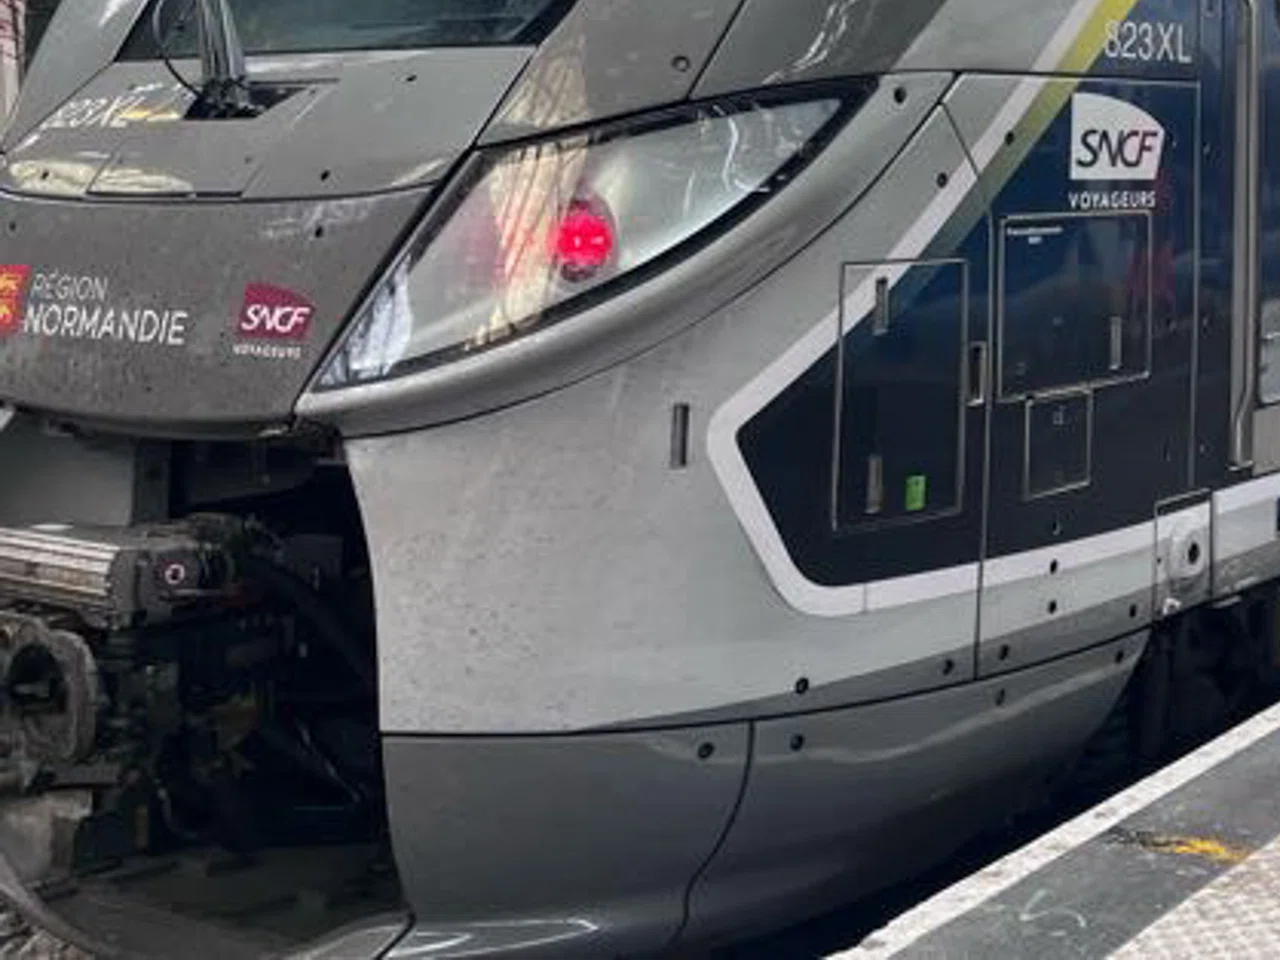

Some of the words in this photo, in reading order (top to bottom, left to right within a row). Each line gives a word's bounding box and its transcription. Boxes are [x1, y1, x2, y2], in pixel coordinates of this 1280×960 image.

[1104, 19, 1193, 64] 823XL
[1076, 129, 1158, 168] SNCF
[1068, 190, 1156, 209] VOYAGEURS
[23, 303, 188, 346] NORMANDIE
[241, 304, 311, 333] SNCF
